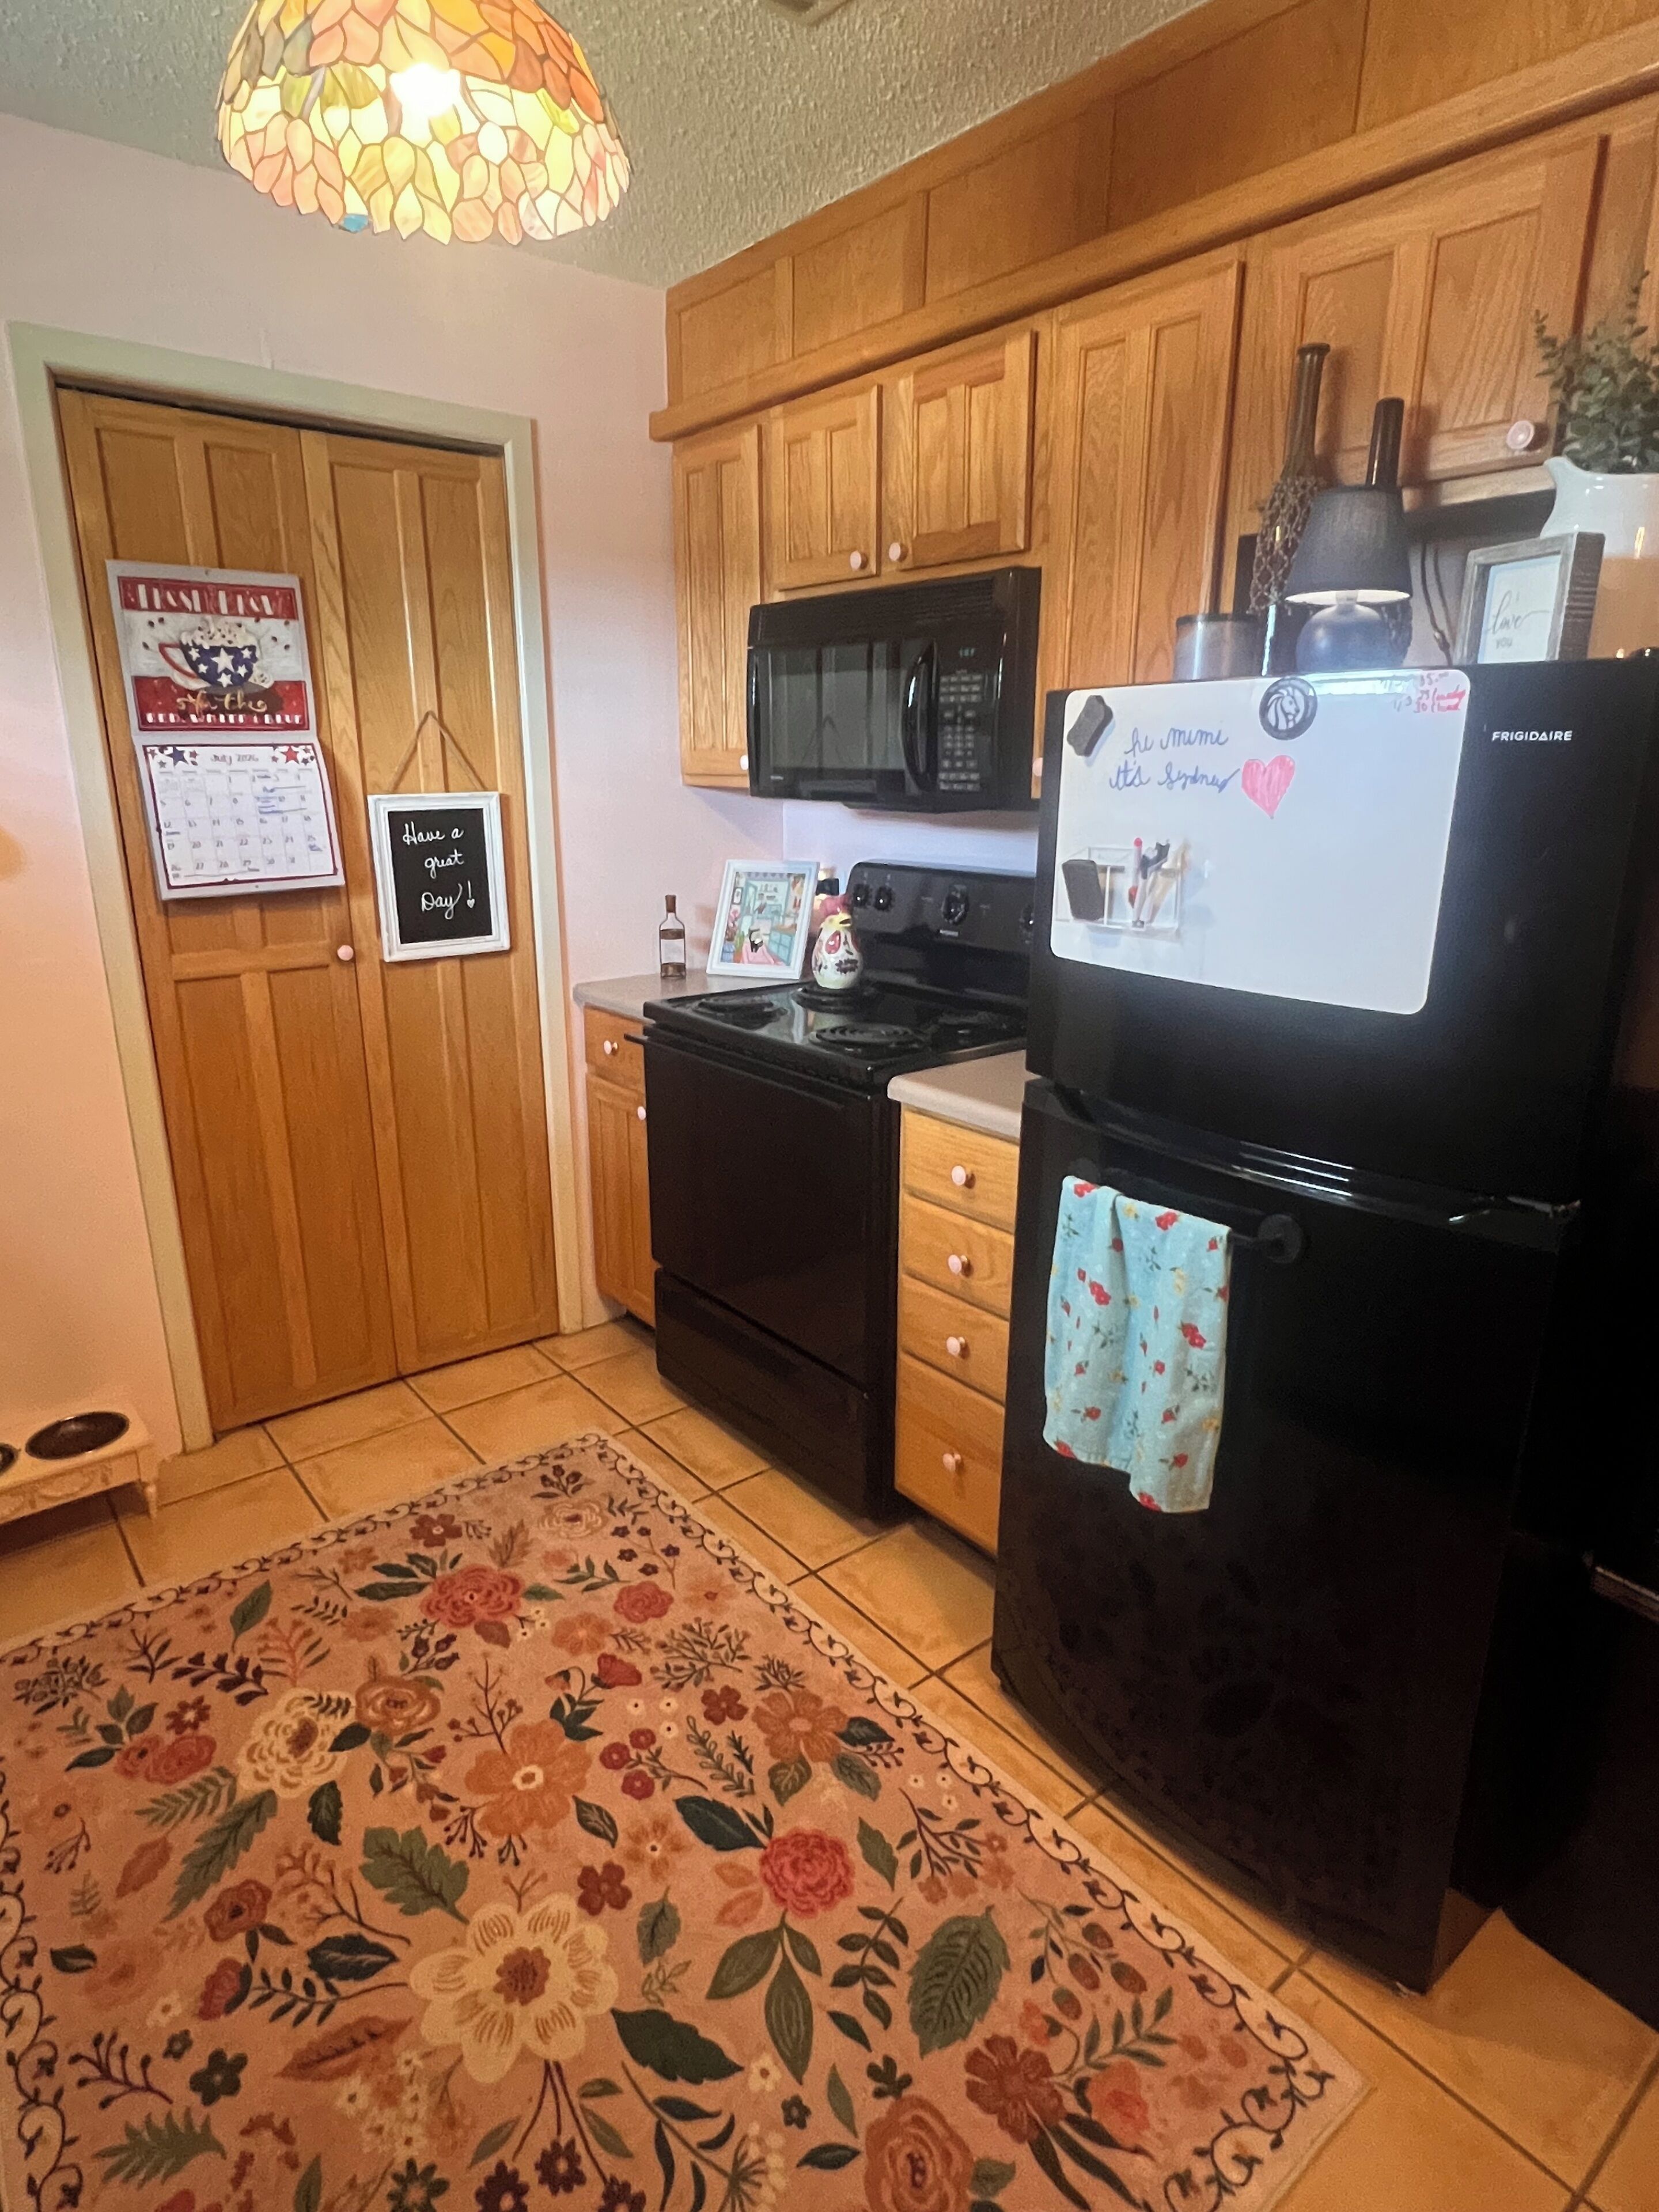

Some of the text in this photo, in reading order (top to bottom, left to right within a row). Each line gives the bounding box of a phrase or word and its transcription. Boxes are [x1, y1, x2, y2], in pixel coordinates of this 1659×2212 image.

[1123, 725, 1229, 758] hi mimi
[1492, 730, 1573, 742] FRIGIDAIRE
[403, 821, 464, 845] Have a
[425, 849, 464, 879] great
